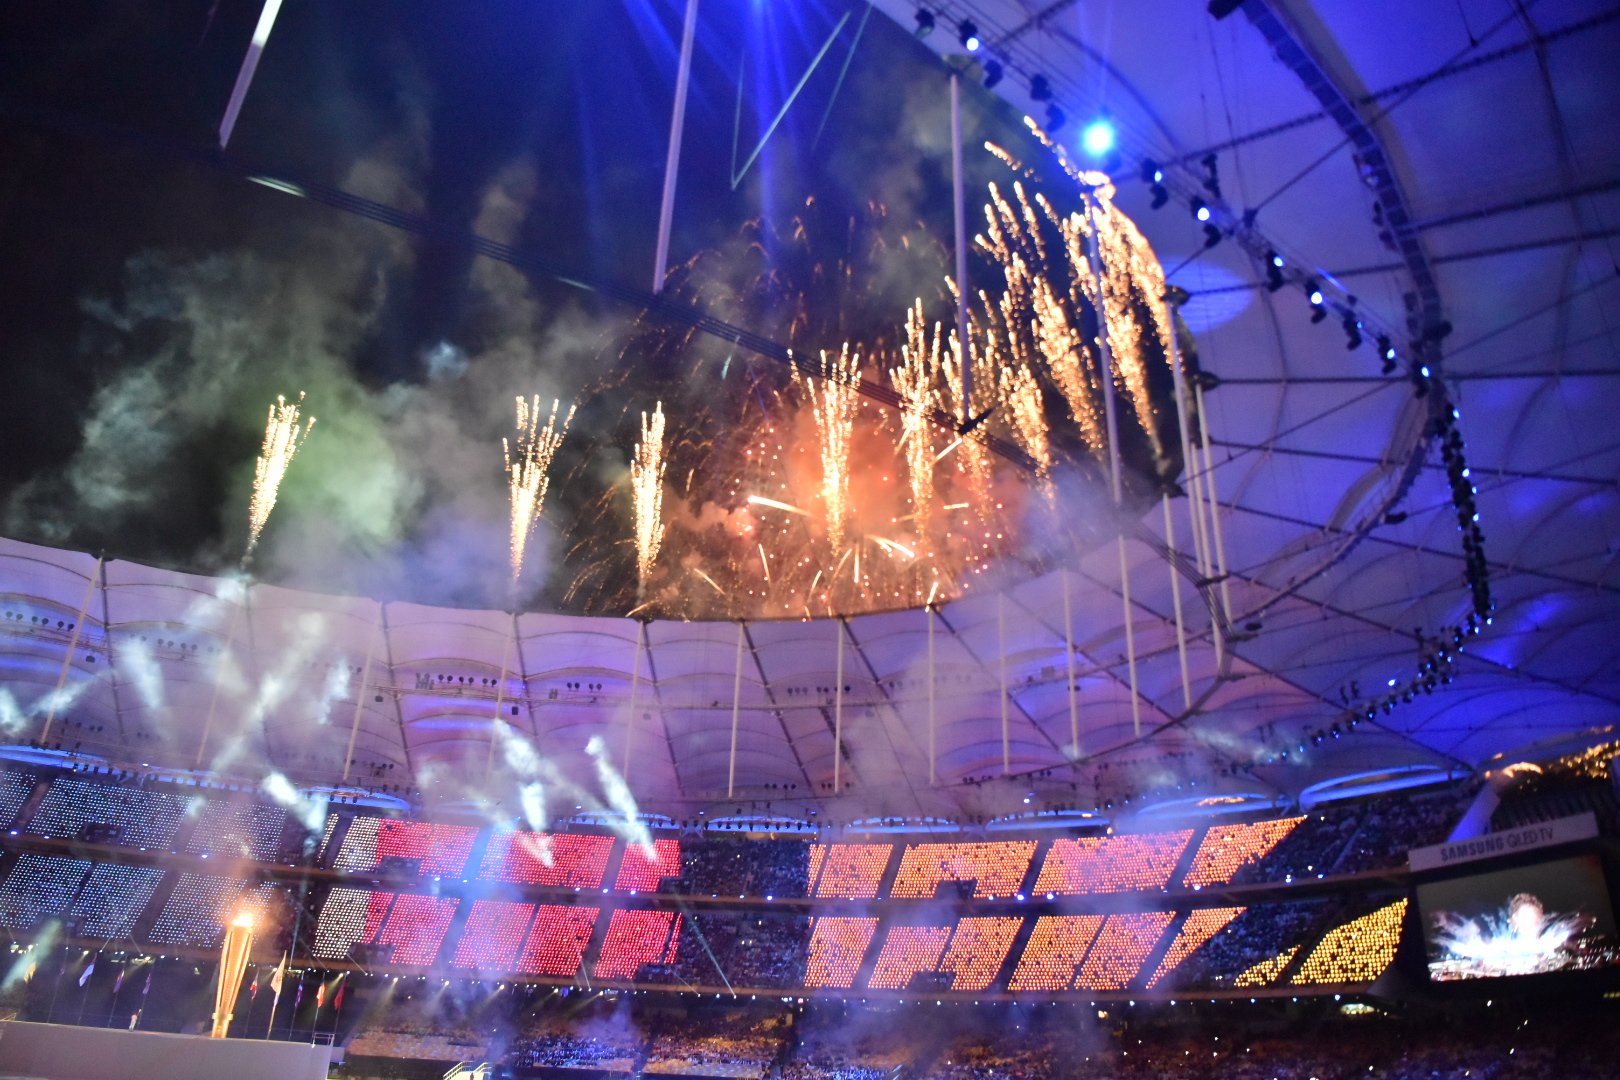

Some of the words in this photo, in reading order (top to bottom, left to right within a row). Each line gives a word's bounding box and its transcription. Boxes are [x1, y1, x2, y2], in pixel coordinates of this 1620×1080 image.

[1440, 837, 1504, 861] SAMSUNG
[1506, 830, 1538, 848] QLED
[1540, 828, 1554, 842] TV
